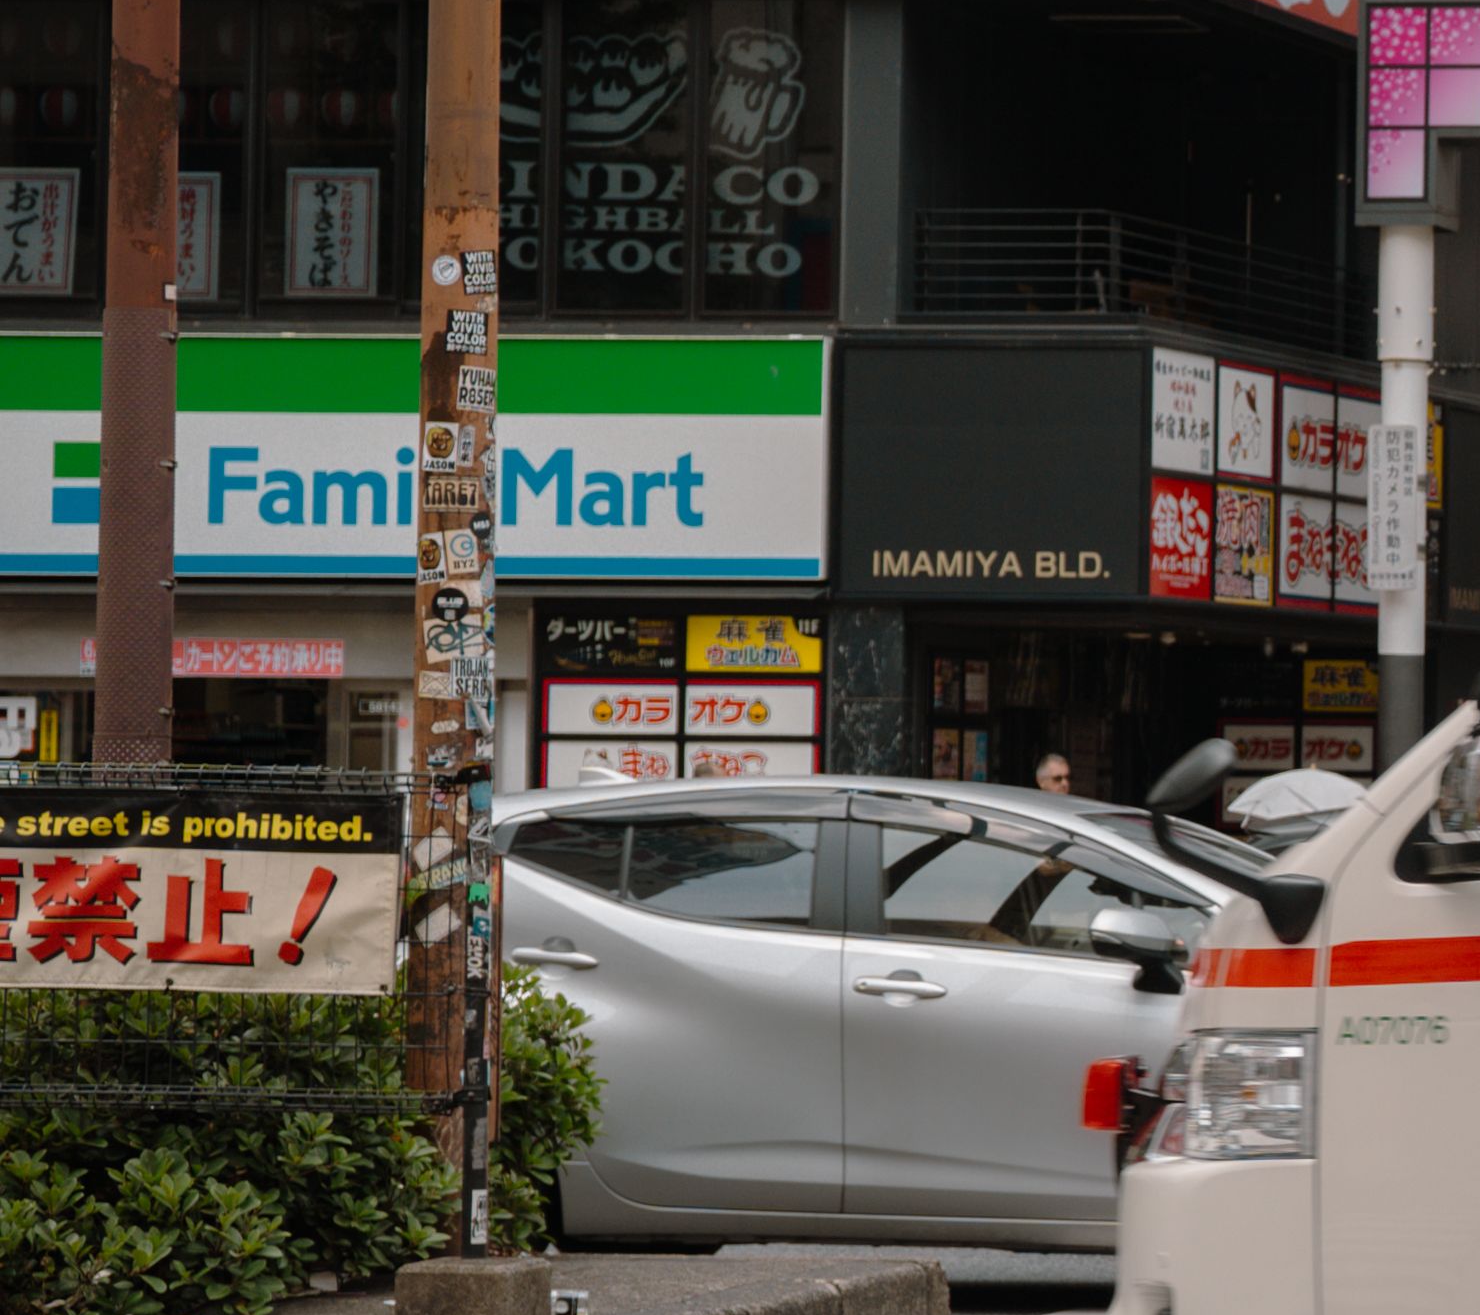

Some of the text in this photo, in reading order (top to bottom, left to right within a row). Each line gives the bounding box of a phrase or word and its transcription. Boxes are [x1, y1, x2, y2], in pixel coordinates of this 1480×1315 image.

[500, 160, 821, 207] INDACO
[308, 180, 338, 288] やきそば
[464, 251, 494, 263] WITH
[465, 262, 496, 274] VIVID
[499, 236, 803, 278] OKOCHO
[463, 273, 497, 286] COLOR
[451, 321, 486, 335] VIVID
[452, 310, 486, 324] WITH
[446, 332, 488, 347] COLOR
[1301, 420, 1368, 472] カラオケ
[423, 460, 456, 470] JASON
[207, 446, 705, 528] FamiMart
[419, 570, 446, 582] JASON
[872, 550, 1111, 579] IMAMIYA BLD.
[547, 619, 626, 642] ダーツバー
[717, 617, 787, 643] 麻雀
[705, 644, 801, 668] ウェルカム
[613, 696, 747, 726] カラオケ
[1250, 738, 1347, 761] カラオケ
[16, 810, 374, 844] street is prohibited.
